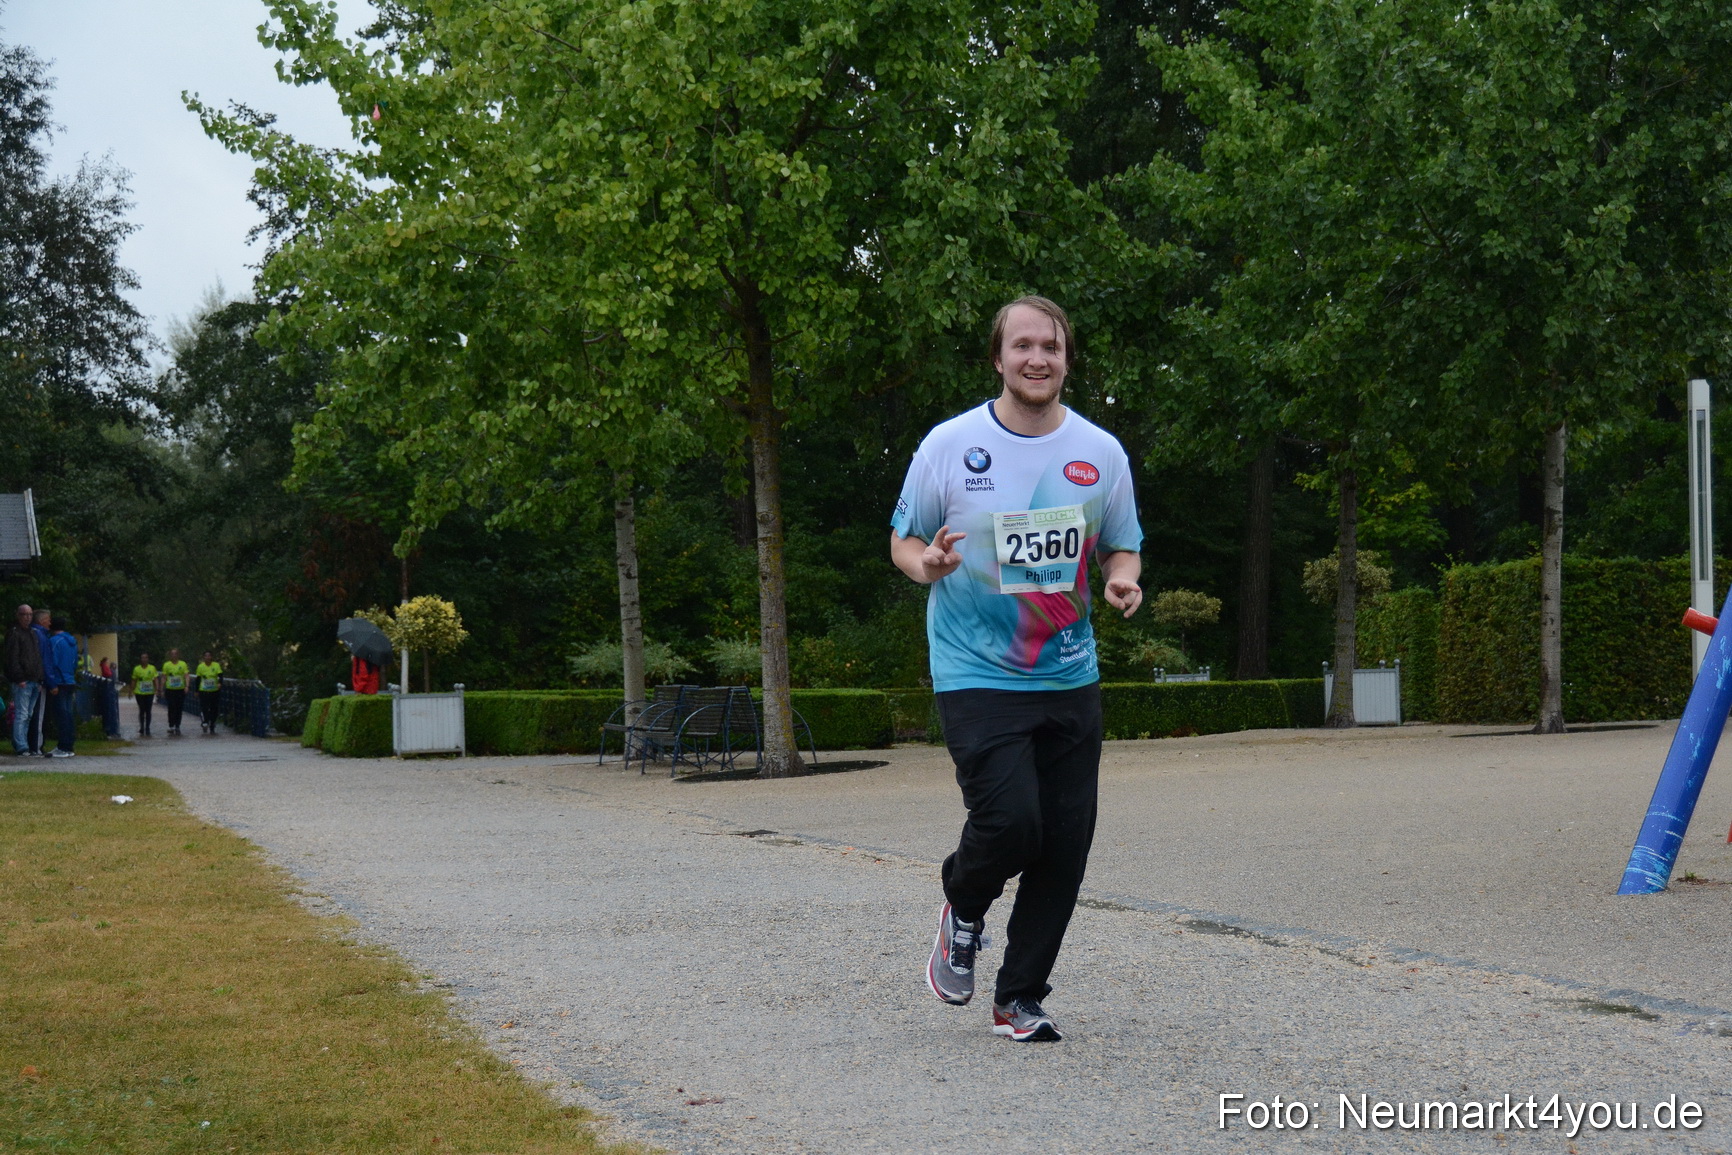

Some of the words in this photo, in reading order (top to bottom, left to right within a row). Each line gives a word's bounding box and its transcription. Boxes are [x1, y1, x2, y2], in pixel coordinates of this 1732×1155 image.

[1068, 465, 1096, 480] Hervis
[965, 477, 995, 486] PARTL
[1034, 509, 1077, 523] BOCK
[1006, 527, 1079, 564] 2560
[1025, 569, 1062, 583] Philipp
